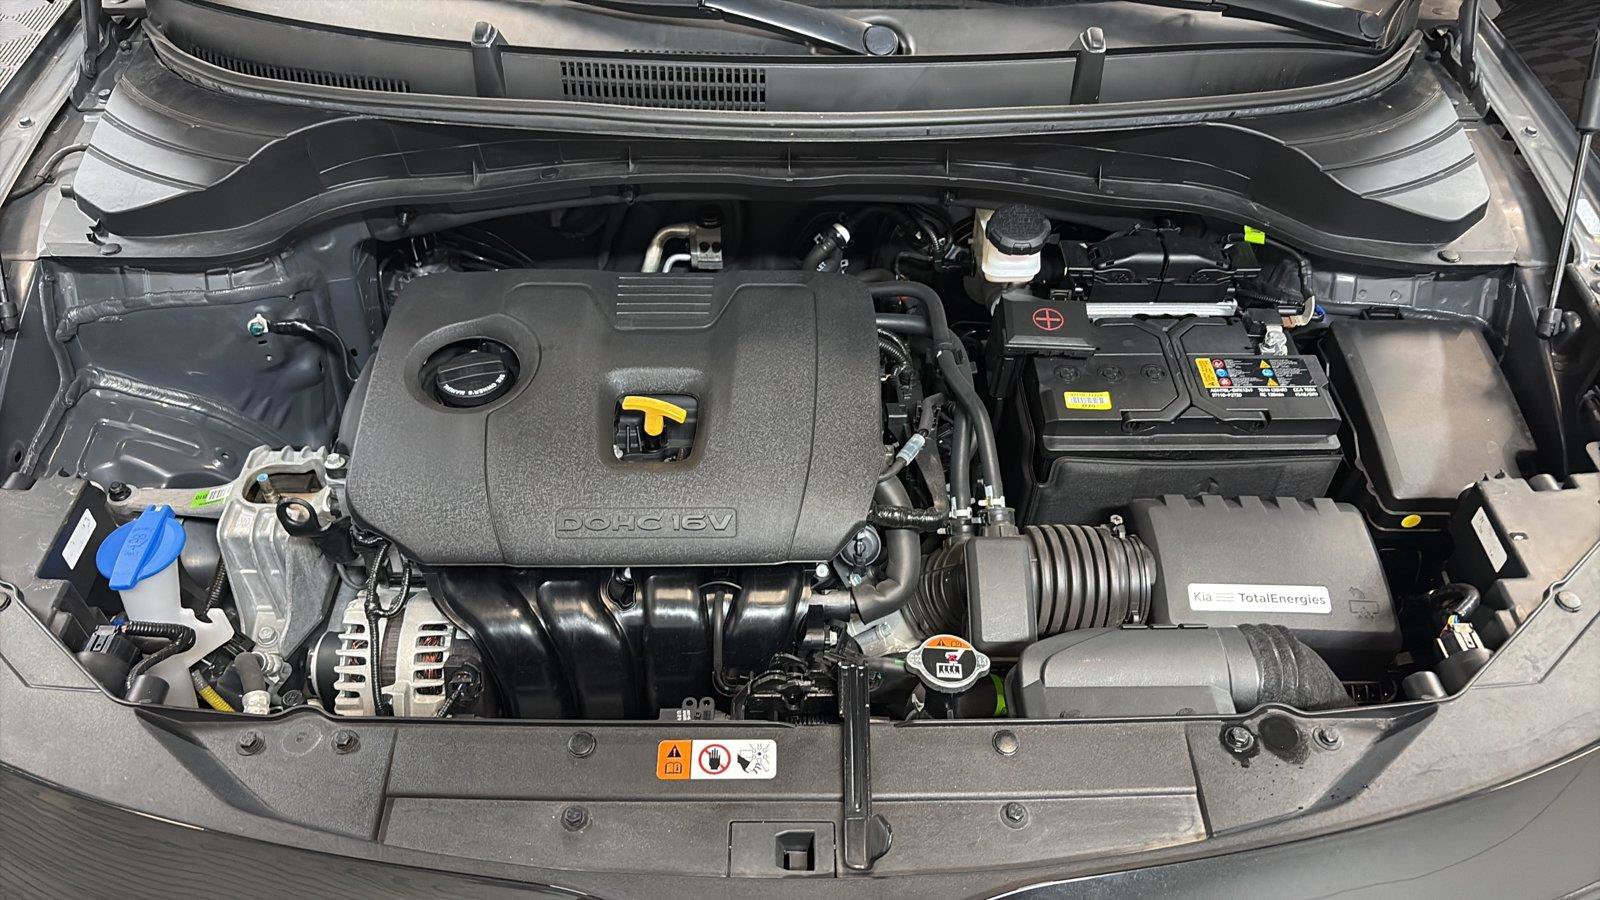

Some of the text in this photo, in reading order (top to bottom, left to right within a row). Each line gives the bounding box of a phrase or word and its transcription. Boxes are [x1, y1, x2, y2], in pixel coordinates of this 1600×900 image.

[442, 383, 466, 396] MANUAL
[467, 382, 498, 396] OWNER'S
[557, 514, 734, 531] DOHC 16V
[1193, 591, 1327, 606] Kia TotalEnergies
